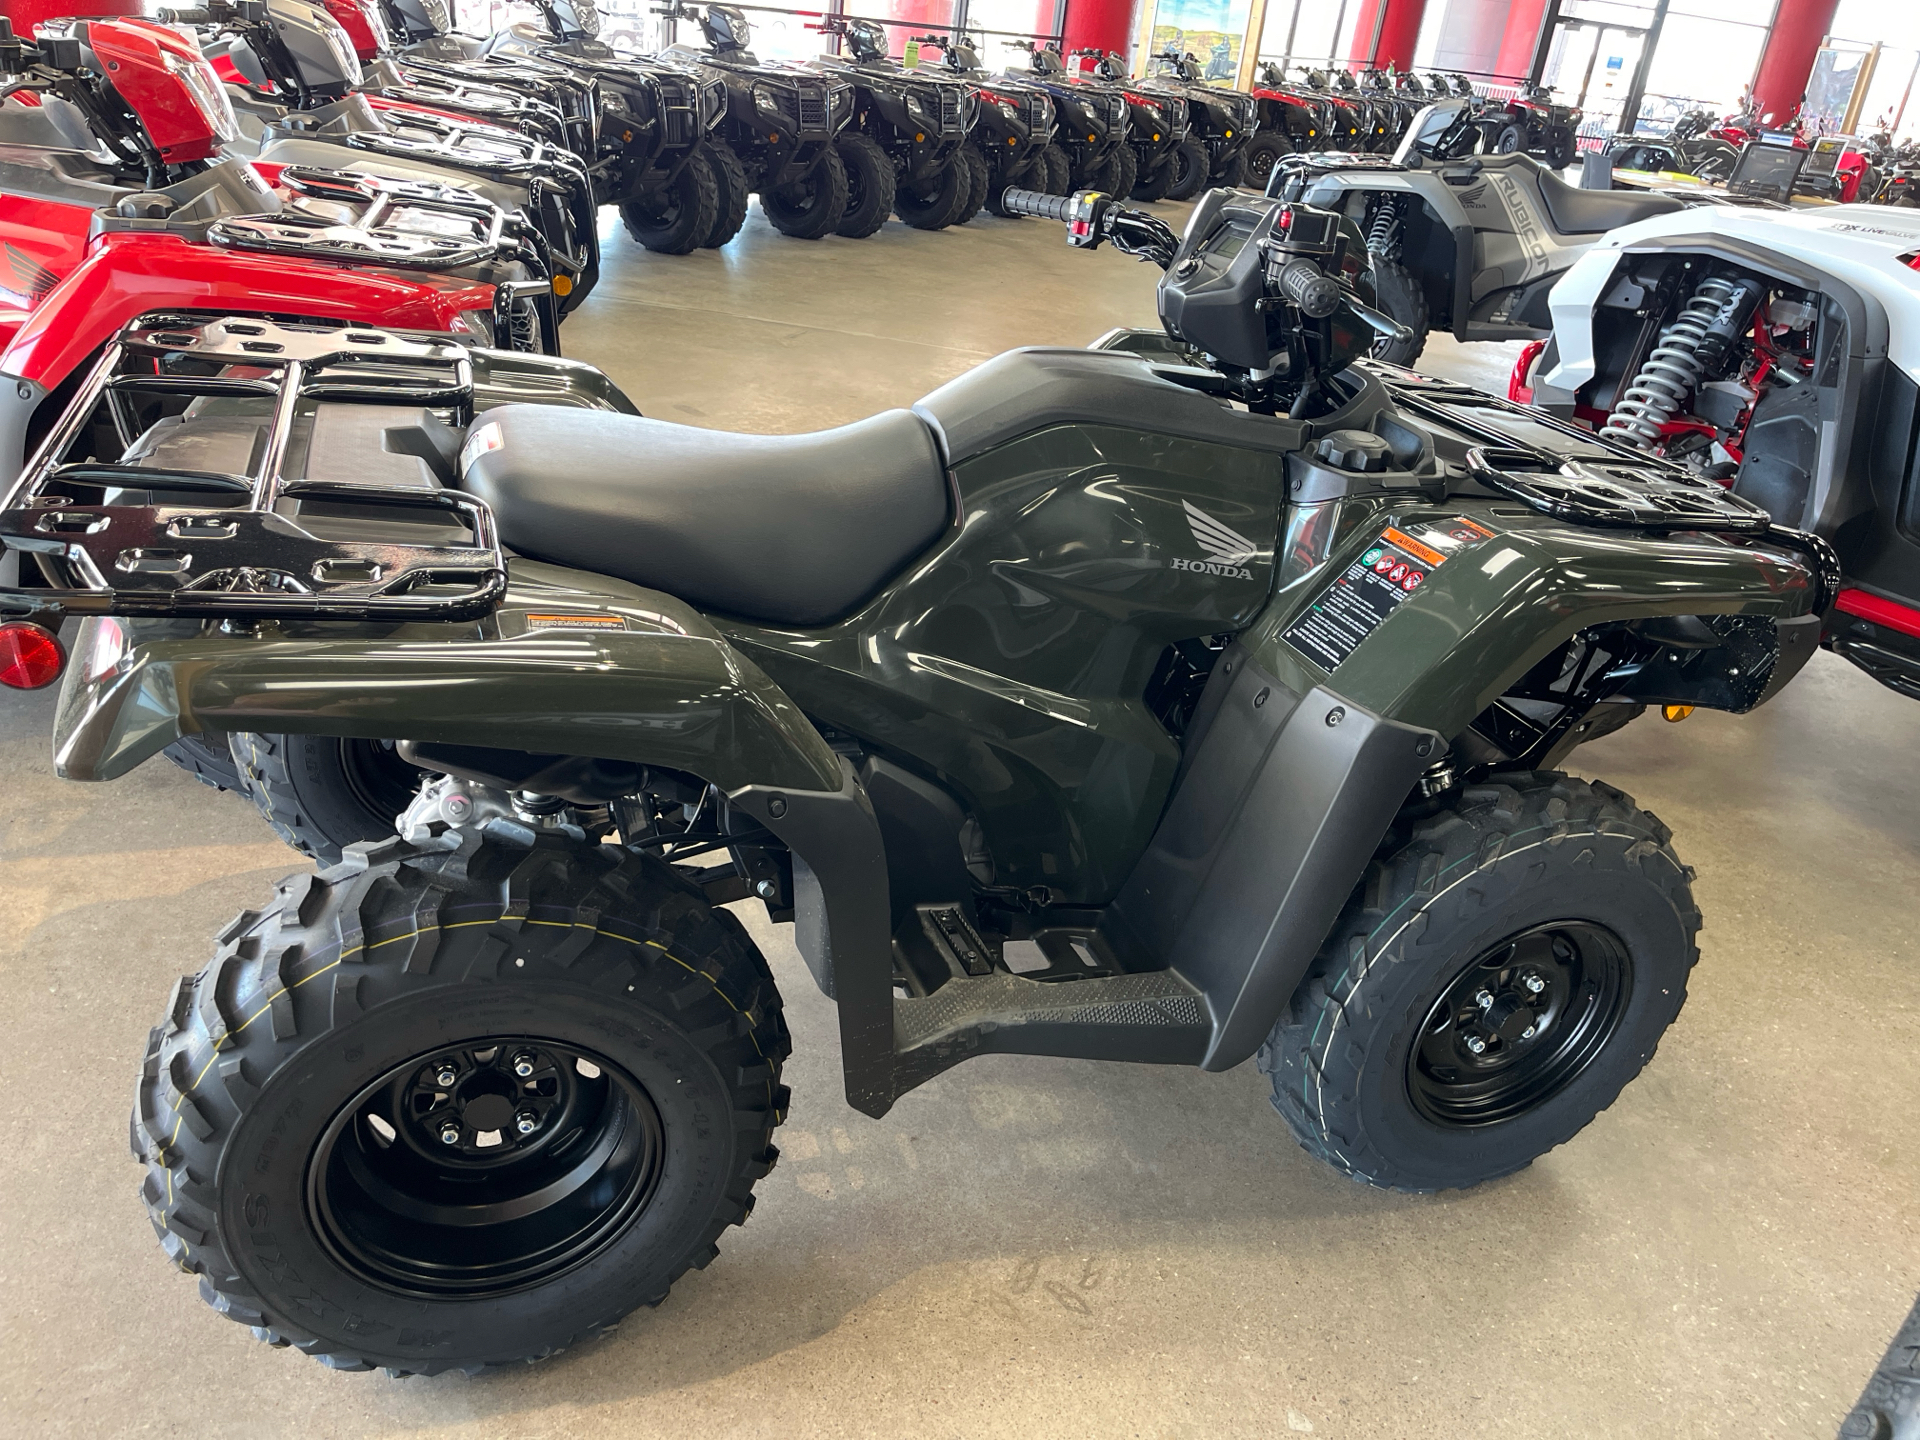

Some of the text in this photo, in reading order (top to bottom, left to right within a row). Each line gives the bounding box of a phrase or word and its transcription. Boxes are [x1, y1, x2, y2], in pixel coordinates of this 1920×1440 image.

[1710, 287, 1748, 326] FOX
[1401, 538, 1430, 558] WARNING
[1171, 558, 1254, 580] HONDA
[242, 1192, 457, 1347] MAXXIS
